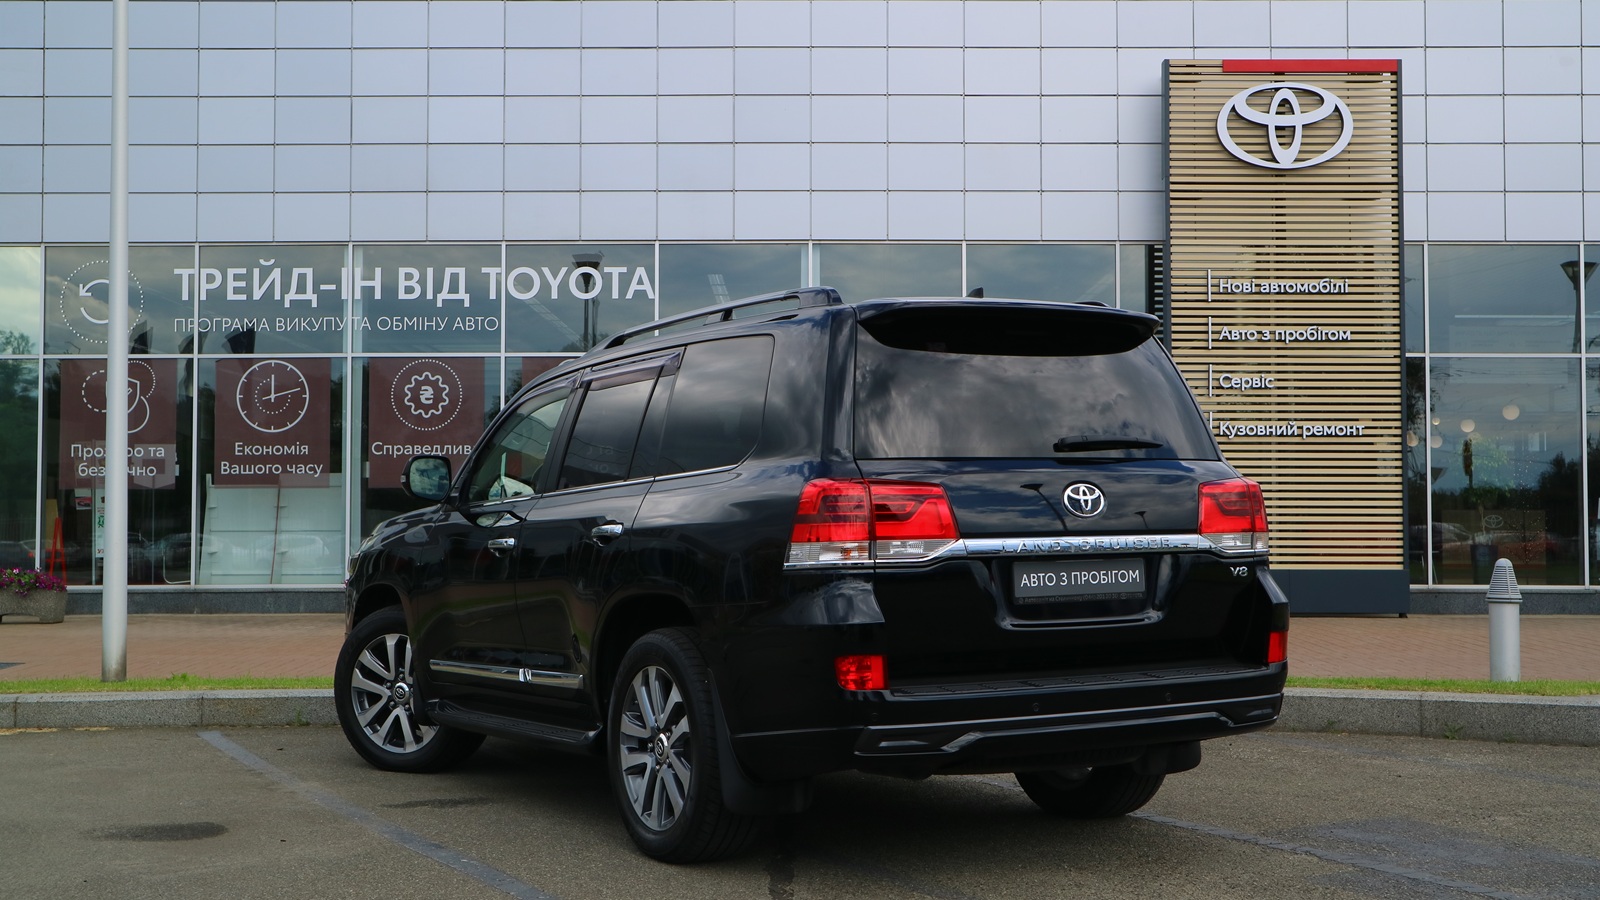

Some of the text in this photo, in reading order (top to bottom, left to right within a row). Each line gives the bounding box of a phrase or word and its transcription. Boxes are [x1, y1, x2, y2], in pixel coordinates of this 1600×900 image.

[173, 258, 655, 308] ТРЕЙД-ІН ВІД TOYOTA
[1219, 278, 1349, 295] Нові автомобілі
[174, 315, 499, 332] ПРОГРАМА ВИКУПУ ТА ОБМІНУ АВТО
[1219, 326, 1351, 344] Авто з пробігом
[1219, 374, 1275, 392] Сервіс
[1219, 421, 1365, 440] Кузовний ремонт
[148, 447, 165, 457] та
[234, 442, 309, 456] Економія
[78, 462, 157, 477] безчно
[220, 461, 323, 477] Вашого часу
[1001, 537, 1171, 554] LAND CRUISER
[1020, 572, 1056, 588] АВТО
[1071, 569, 1140, 585] ПРОБІГОМ
[1230, 566, 1248, 577] V8
